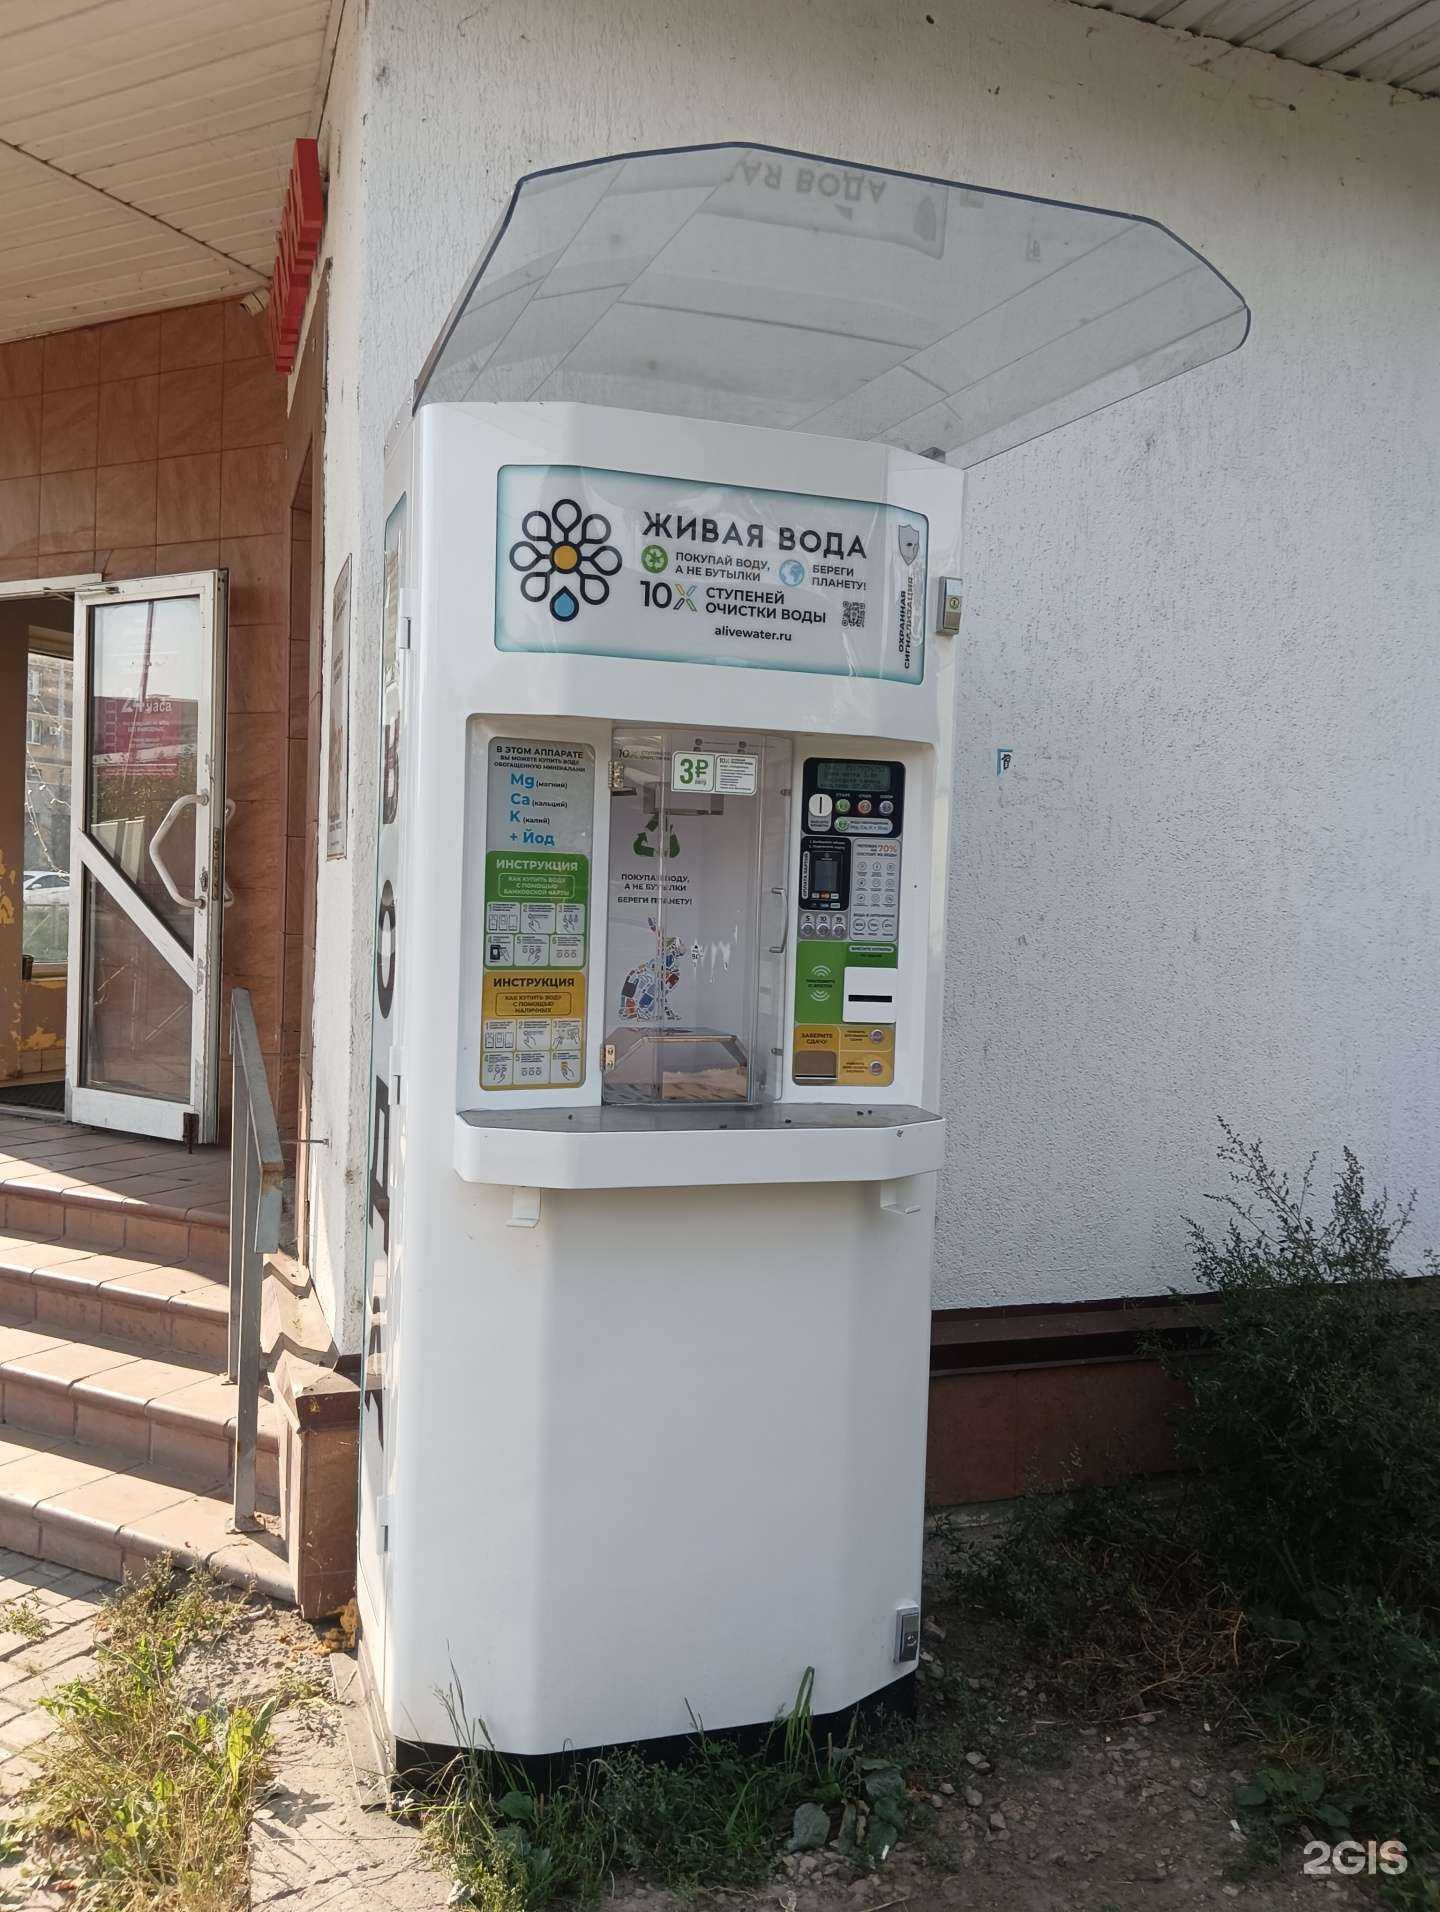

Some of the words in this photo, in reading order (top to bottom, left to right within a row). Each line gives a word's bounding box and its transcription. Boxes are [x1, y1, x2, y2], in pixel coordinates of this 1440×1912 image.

[642, 511, 764, 549] ЖИВАЯ
[778, 526, 868, 560] ВОДА
[675, 551, 733, 567] ПОКУПАЙ
[736, 557, 771, 572] ВОДУ,
[675, 564, 684, 575] А
[686, 565, 702, 577] НЕ
[705, 567, 761, 582] БУТЫЛКИ
[812, 563, 855, 577] БЕРЕГИ
[811, 576, 867, 592] ПЛАНЕТУ!
[706, 586, 785, 605] СТУПЕНЕЙ
[705, 601, 777, 620] ОЧИСТКИ
[781, 608, 827, 624] ВОДЫ
[898, 590, 907, 653] ОХРАННАЯ
[904, 576, 914, 670] СИГНАЛИЗАЦИЯ
[714, 625, 792, 642] alivewater.ru
[496, 745, 503, 753] В
[505, 746, 532, 755] ЭТОМ
[534, 748, 584, 759] АППАРАТЕ
[510, 773, 535, 789] Mg
[536, 780, 568, 789] (магний)
[510, 793, 530, 806] Ca
[532, 799, 568, 808] (кальций)
[523, 816, 551, 825] (калий)
[523, 829, 555, 846] Йод
[496, 859, 578, 872] ИНСТРУКЦИЯ
[621, 873, 663, 881] ПОКУПА
[617, 896, 649, 904] БЕРЕГИ
[493, 977, 575, 989] ИНСТРУКЦИЯ
